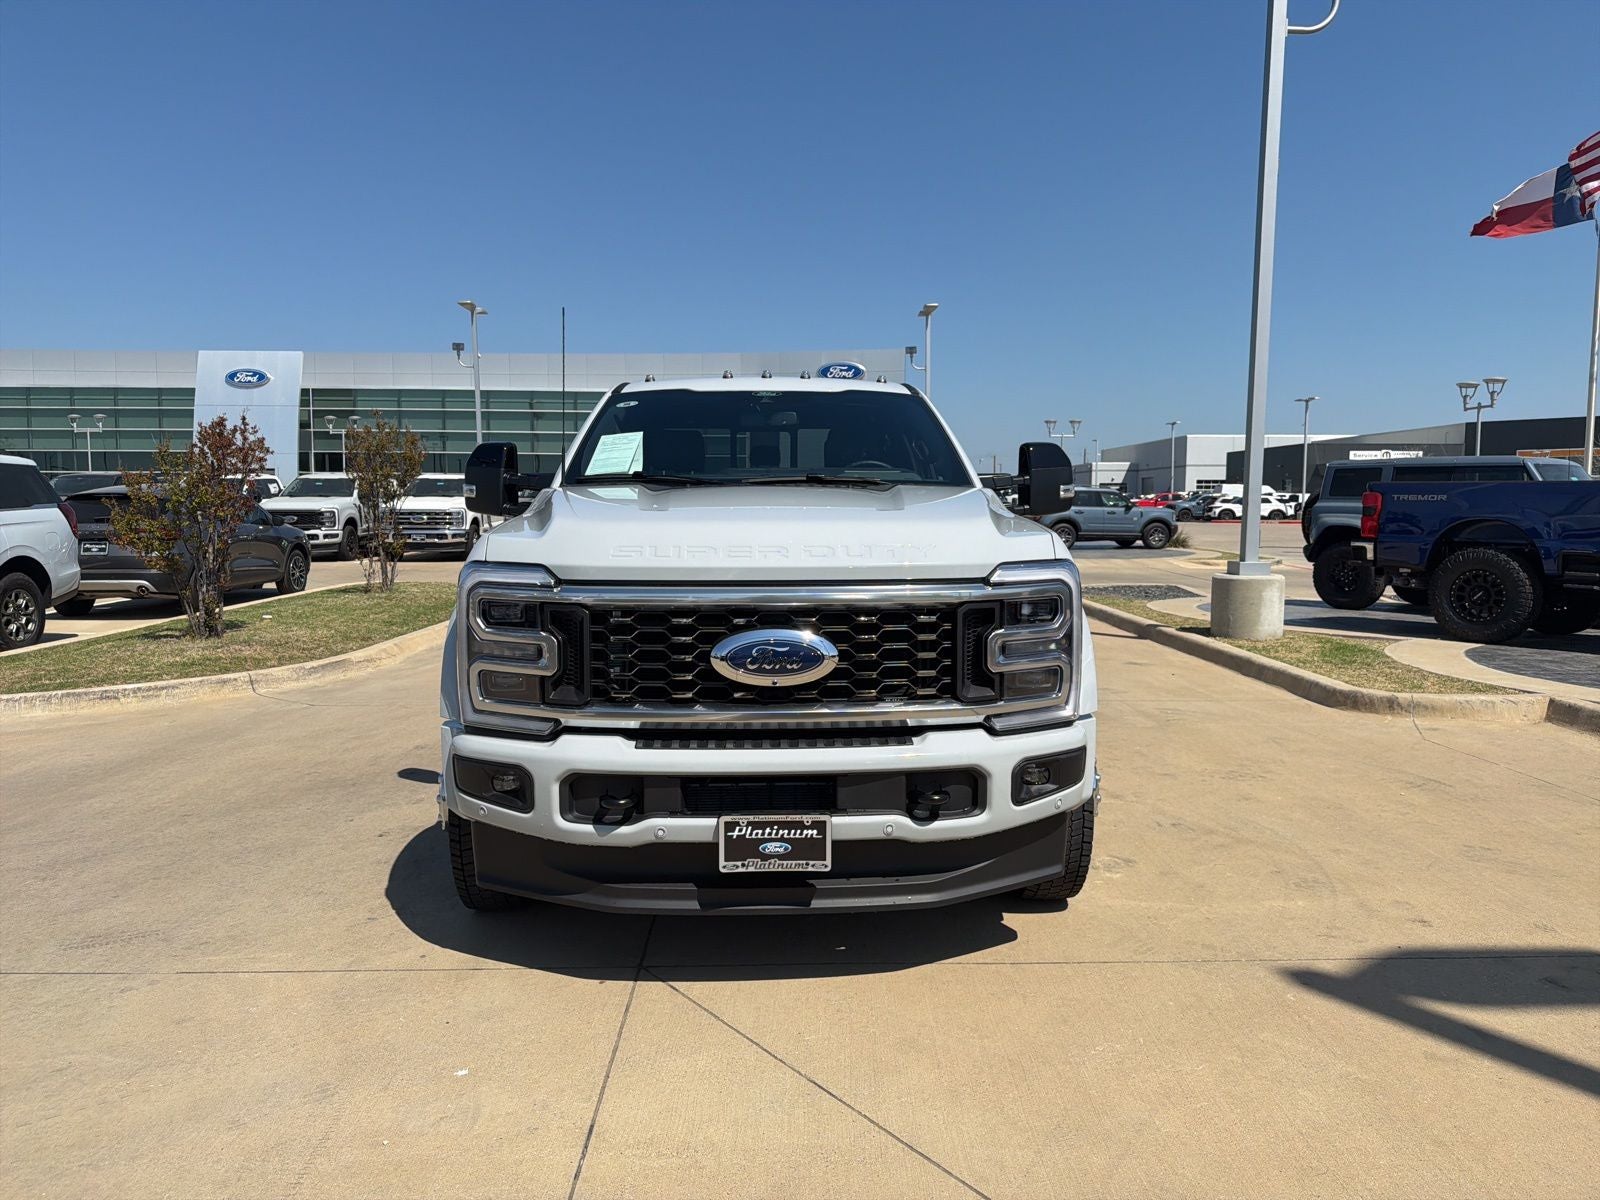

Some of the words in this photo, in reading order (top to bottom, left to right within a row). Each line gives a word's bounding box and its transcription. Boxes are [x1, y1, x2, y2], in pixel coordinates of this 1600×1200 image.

[234, 371, 259, 382] Ford
[827, 365, 855, 378] Ford
[609, 544, 791, 560] SUPER
[801, 543, 937, 560] DUTY
[745, 645, 805, 670] Ford
[727, 825, 823, 839] Platinum
[765, 844, 785, 853] Ford
[745, 859, 806, 870] Platinum
